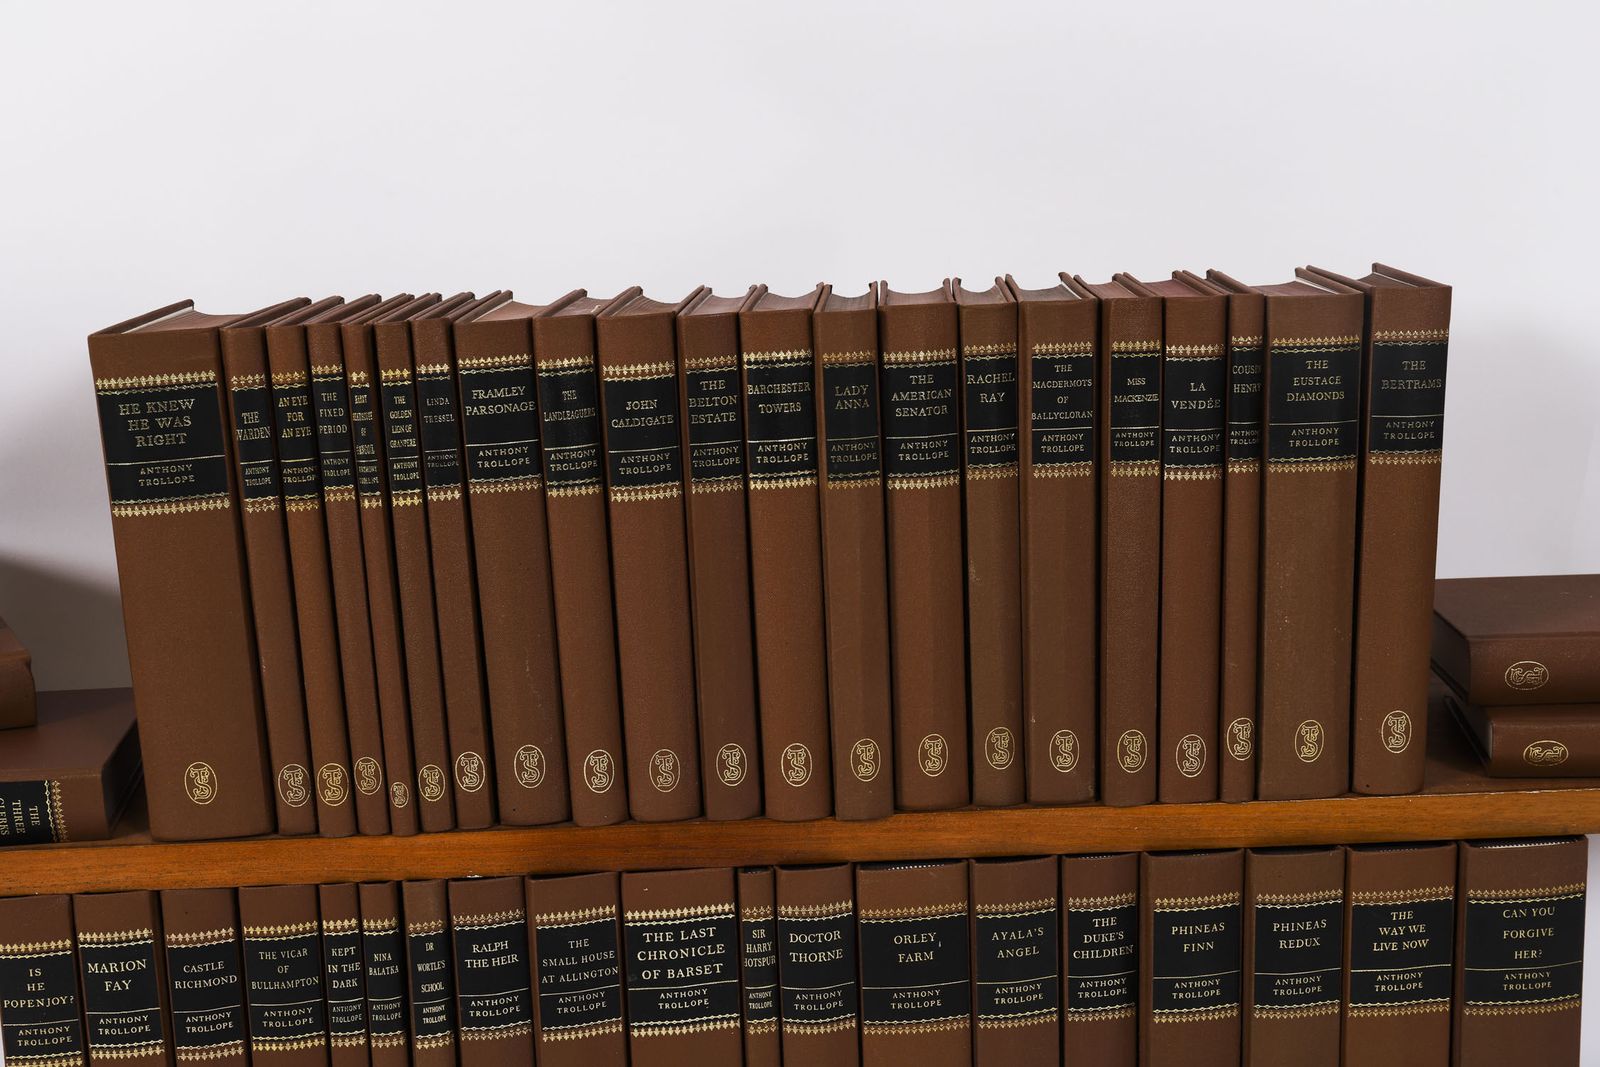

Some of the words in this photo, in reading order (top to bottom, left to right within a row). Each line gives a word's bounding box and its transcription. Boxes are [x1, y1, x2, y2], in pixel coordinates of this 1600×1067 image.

[1055, 364, 1072, 372] THE
[1233, 365, 1262, 374] COUSI
[1306, 360, 1329, 369] THE
[1402, 360, 1426, 370] THE
[910, 374, 934, 385] THE
[967, 373, 1015, 385] RACHEL
[1033, 378, 1092, 389] MACDERMOTS
[1294, 376, 1341, 385] EUSTACE
[1382, 379, 1441, 390] BERTRAMS
[700, 380, 725, 391] THE
[748, 382, 811, 394] BARCHESTER
[835, 384, 869, 396] LADY
[1190, 383, 1206, 392] LA
[1233, 383, 1262, 393] HENRY
[321, 393, 337, 401] THE
[472, 386, 526, 399] FRAMLEY
[562, 390, 577, 400] THE
[892, 389, 952, 401] AMERICAN
[980, 392, 1005, 403] RAY
[1287, 391, 1345, 402] DIAMONDS
[278, 398, 291, 407] AN
[292, 395, 308, 406] EYE
[394, 396, 405, 404] THE
[427, 398, 450, 406] LINDA
[689, 395, 737, 408] BELTON
[1057, 396, 1068, 404] OF
[1114, 394, 1159, 403] MACKENZIE
[1171, 398, 1220, 410] VENDÉE
[119, 403, 141, 416] HE
[147, 399, 195, 414] KNEW
[466, 402, 536, 416] PARSONAGE
[626, 400, 657, 411] JOHN
[759, 402, 801, 414] TOWERS
[835, 400, 870, 410] ANNA
[320, 408, 344, 417] FIXED
[390, 410, 412, 419] GOLDEN
[544, 408, 596, 421] LANDLEAGUERS
[895, 405, 948, 417] SENATOR
[1032, 410, 1093, 420] BALLYCLORAN
[242, 412, 259, 424] THE
[287, 412, 304, 422] FOR
[424, 414, 454, 423] TRESSEL
[612, 415, 674, 428] CALDIGATE
[691, 412, 736, 424] ESTATE
[128, 419, 149, 431] HE
[155, 416, 192, 429] WAS
[404, 424, 412, 432] OF
[237, 427, 270, 441] WARDEN
[282, 428, 294, 438] AN
[295, 427, 311, 437] EYE
[319, 425, 347, 434] PERIOD
[135, 433, 187, 447] RIGHT
[900, 440, 948, 450] ANTHONY
[478, 447, 528, 457] ANTHONY
[758, 442, 808, 453] ANTHONY
[621, 453, 671, 463] ANTHONY
[756, 454, 808, 464] TROLLOPE
[899, 451, 949, 460] TROLLOPE
[477, 457, 530, 468] TROLLOPE
[140, 464, 192, 475] ANTHONY
[619, 463, 672, 475] TROLLOPE
[139, 475, 194, 486] TROLLOPE
[12, 800, 25, 833] THREE
[29, 806, 40, 826] THE
[1391, 910, 1414, 921] THE
[1503, 909, 1528, 919] CAN
[1532, 907, 1556, 916] YOU
[1092, 917, 1117, 928] THE
[1273, 919, 1327, 932] PHINEAS
[752, 929, 766, 939] SIR
[992, 927, 1044, 941] AYALA'S
[1171, 922, 1225, 935] PHINEAS
[1379, 926, 1406, 936] WAY
[1409, 924, 1426, 933] WE
[1503, 927, 1554, 939] FORGIVE
[643, 932, 674, 943] THE
[680, 927, 717, 940] LAST
[789, 930, 841, 943] DOCTOR
[894, 932, 937, 945] ORLEY
[1084, 931, 1124, 943] DUKE'S
[425, 943, 434, 951] DR
[472, 941, 509, 953] RALPH
[568, 939, 590, 949] THE
[746, 942, 772, 953] HARRY
[1184, 941, 1215, 953] FINN
[1279, 937, 1320, 949] REDUX
[1373, 941, 1398, 951] LIVE
[1403, 939, 1429, 950] NOW
[259, 951, 278, 960] THE
[281, 948, 308, 958] VICAR
[332, 947, 356, 956] KEPT
[637, 944, 726, 961] CHRONICLE
[790, 949, 843, 963] THORNE
[898, 951, 934, 963] FARM
[997, 946, 1039, 959] ANGEL
[1073, 945, 1134, 959] CHILDREN
[1514, 949, 1543, 959] HER?
[374, 953, 392, 962] NINA
[465, 958, 489, 968] THE
[492, 954, 519, 966] HEIR
[542, 957, 578, 967] SMALL
[581, 951, 615, 963] HOUSE
[88, 959, 147, 973] MARION
[183, 961, 224, 973] CASTLE
[278, 965, 290, 973] OF
[328, 965, 338, 973] IN
[341, 962, 360, 972] THE
[369, 965, 399, 976] BALATKA
[417, 960, 446, 972] WORTLE'S
[642, 969, 661, 980] OF
[667, 963, 724, 979] BARSET
[29, 968, 41, 977] IS
[541, 975, 555, 984] AT
[559, 967, 619, 983] ALLINGTON
[1376, 972, 1423, 981] ANTHONY
[1504, 972, 1551, 981] ANTHONY
[105, 979, 132, 991] FAY
[175, 975, 238, 989] RICHMOND
[252, 976, 319, 989] BULLHAMPTON
[333, 978, 358, 988] DARK
[1174, 978, 1221, 989] ANTHONY
[1275, 976, 1322, 985] ANTHONY
[1503, 981, 1552, 991] TROLLOPE
[27, 983, 45, 991] HE
[421, 982, 444, 992] SCHOOL
[995, 983, 1043, 994] ANTHONY
[1273, 985, 1322, 996] TROLLOPE
[1375, 982, 1423, 992] TROLLOPE
[660, 988, 708, 999] ANTHONY
[795, 990, 843, 1000] ANTHONY
[892, 989, 941, 999] ANTHONY
[994, 993, 1044, 1005] TROLLOPE
[1172, 988, 1221, 1000] TROLLOPE
[4, 996, 74, 1008] POPENJOY?
[470, 995, 520, 1006] ANTHONY
[658, 999, 710, 1010] TROLLOPE
[794, 1000, 844, 1011] TROLLOPE
[890, 999, 942, 1010] TROLLOPE
[264, 1007, 313, 1017] ANTHONY
[469, 1005, 520, 1017] TROLLOPE
[99, 1015, 149, 1025] ANTHONY
[263, 1017, 314, 1028] TROLLOPE
[18, 1026, 70, 1036] ANTHONY
[98, 1025, 150, 1035] TROLLOPE
[17, 1036, 73, 1046] TROLLOPE
